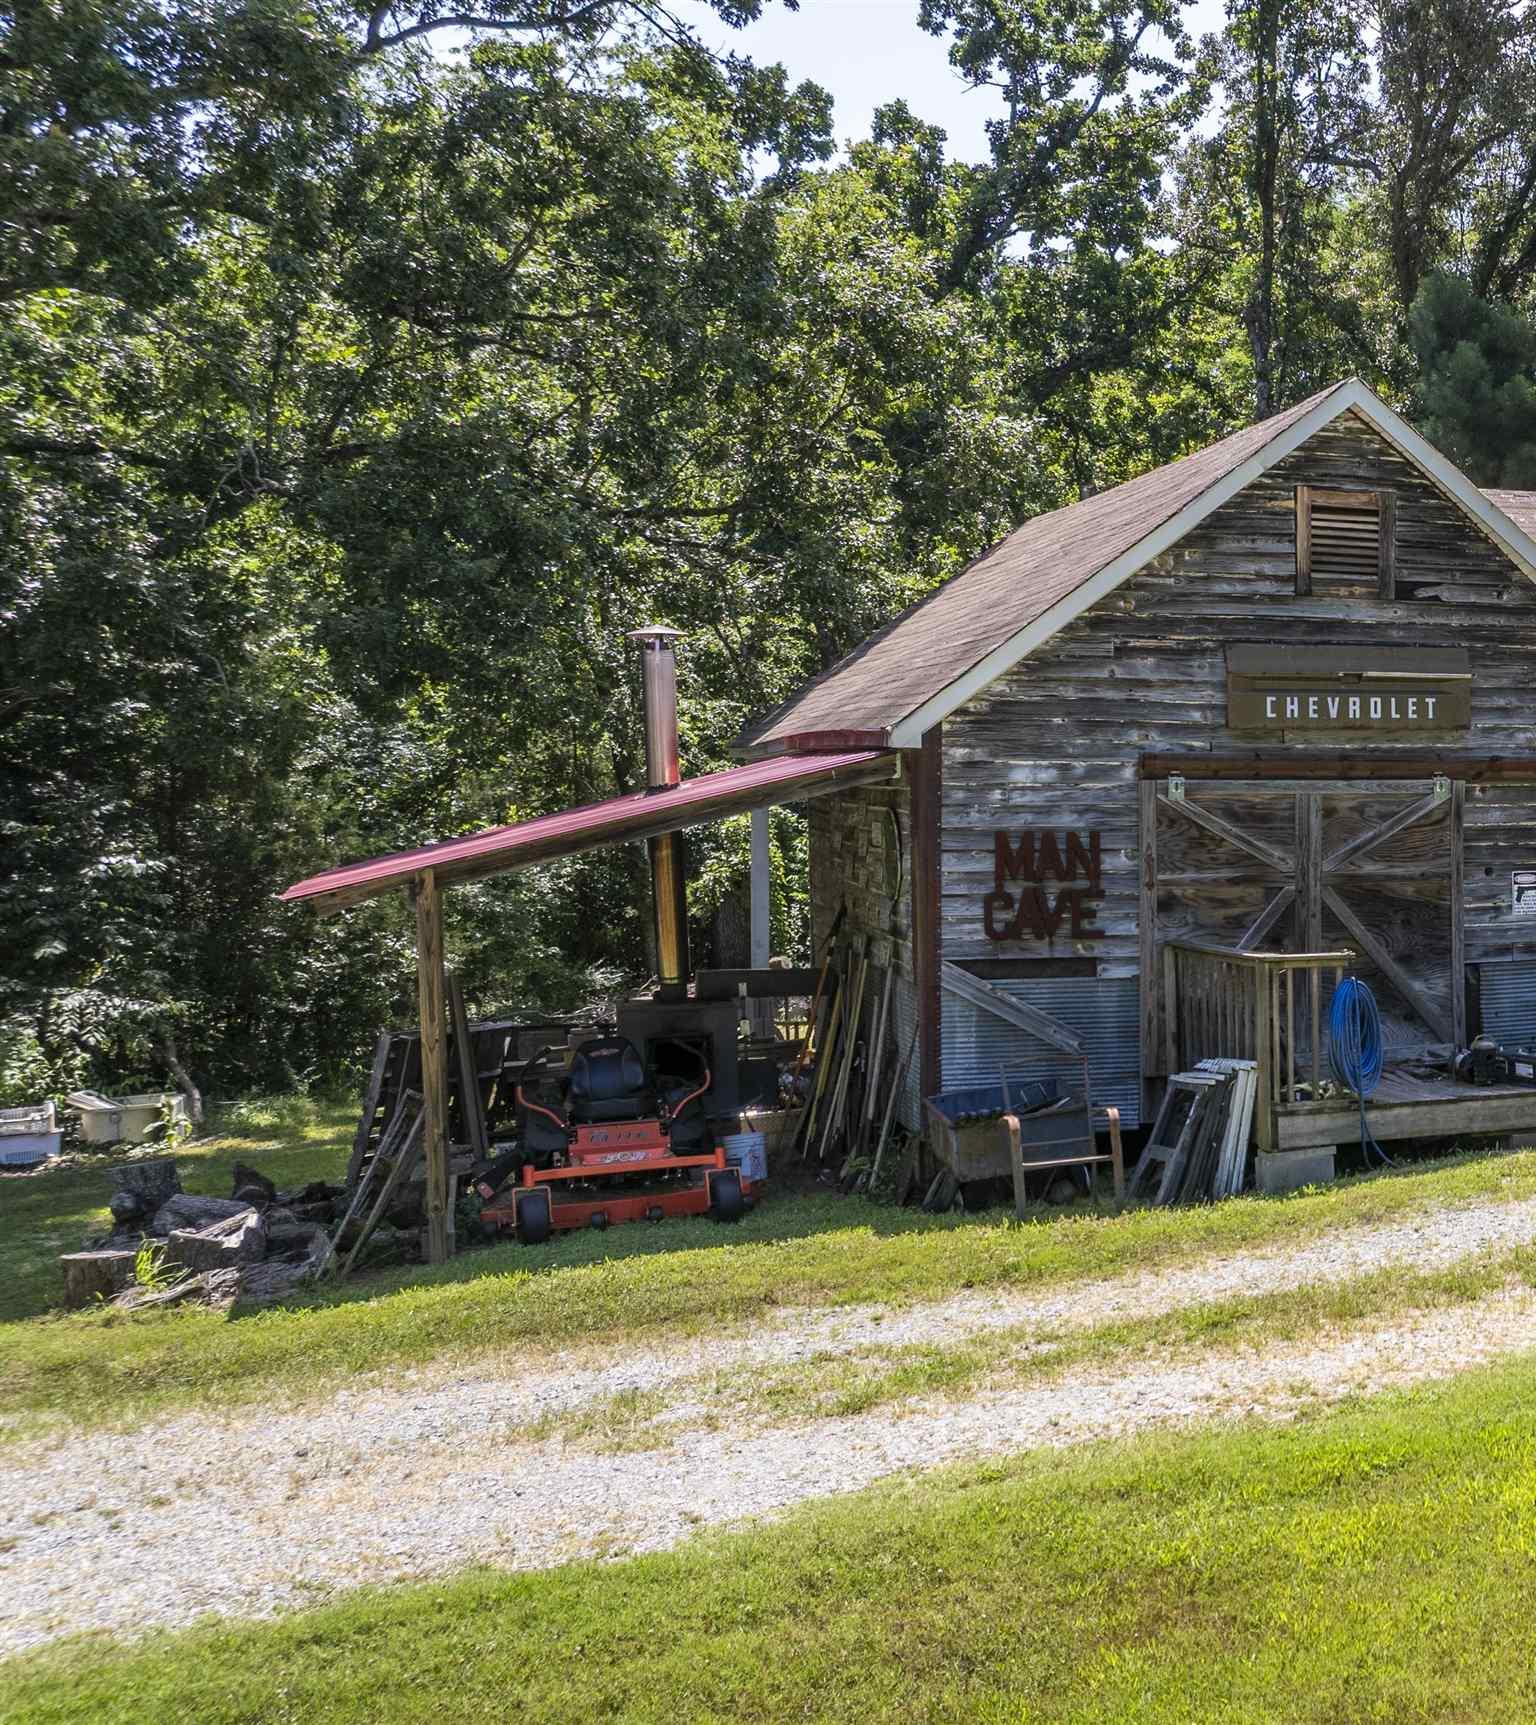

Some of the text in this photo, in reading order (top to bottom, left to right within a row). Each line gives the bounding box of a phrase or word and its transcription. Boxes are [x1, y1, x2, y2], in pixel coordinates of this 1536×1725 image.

[1265, 696, 1436, 720] CHEVROLET
[994, 831, 1101, 889] MAN
[983, 887, 1105, 942] CAVE
